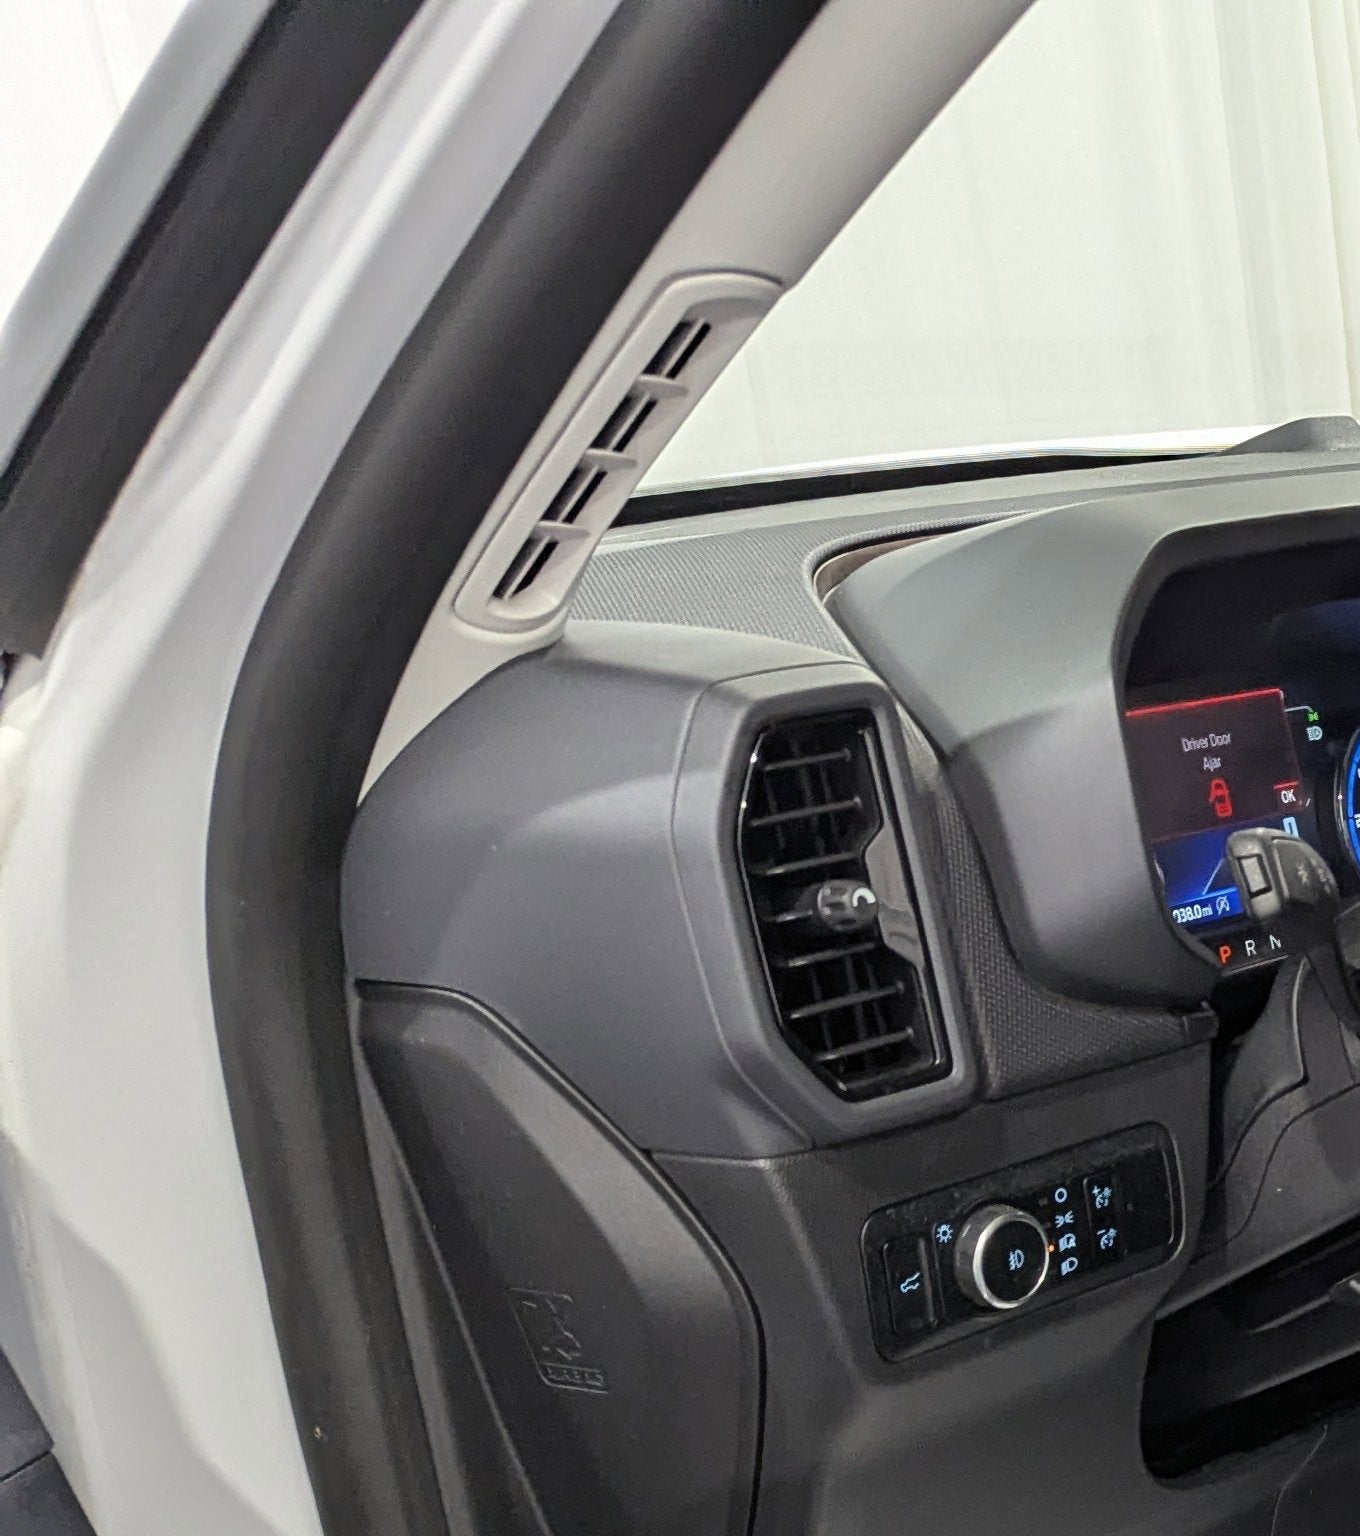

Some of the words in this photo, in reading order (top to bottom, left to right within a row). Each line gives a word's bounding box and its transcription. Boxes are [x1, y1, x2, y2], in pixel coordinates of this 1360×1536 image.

[1181, 737, 1209, 752] Driver
[1209, 733, 1231, 747] Door
[1203, 756, 1222, 772] Ajar
[1280, 789, 1297, 804] OK
[1219, 943, 1233, 964] P
[1244, 939, 1257, 957] R
[1269, 934, 1282, 950] N
